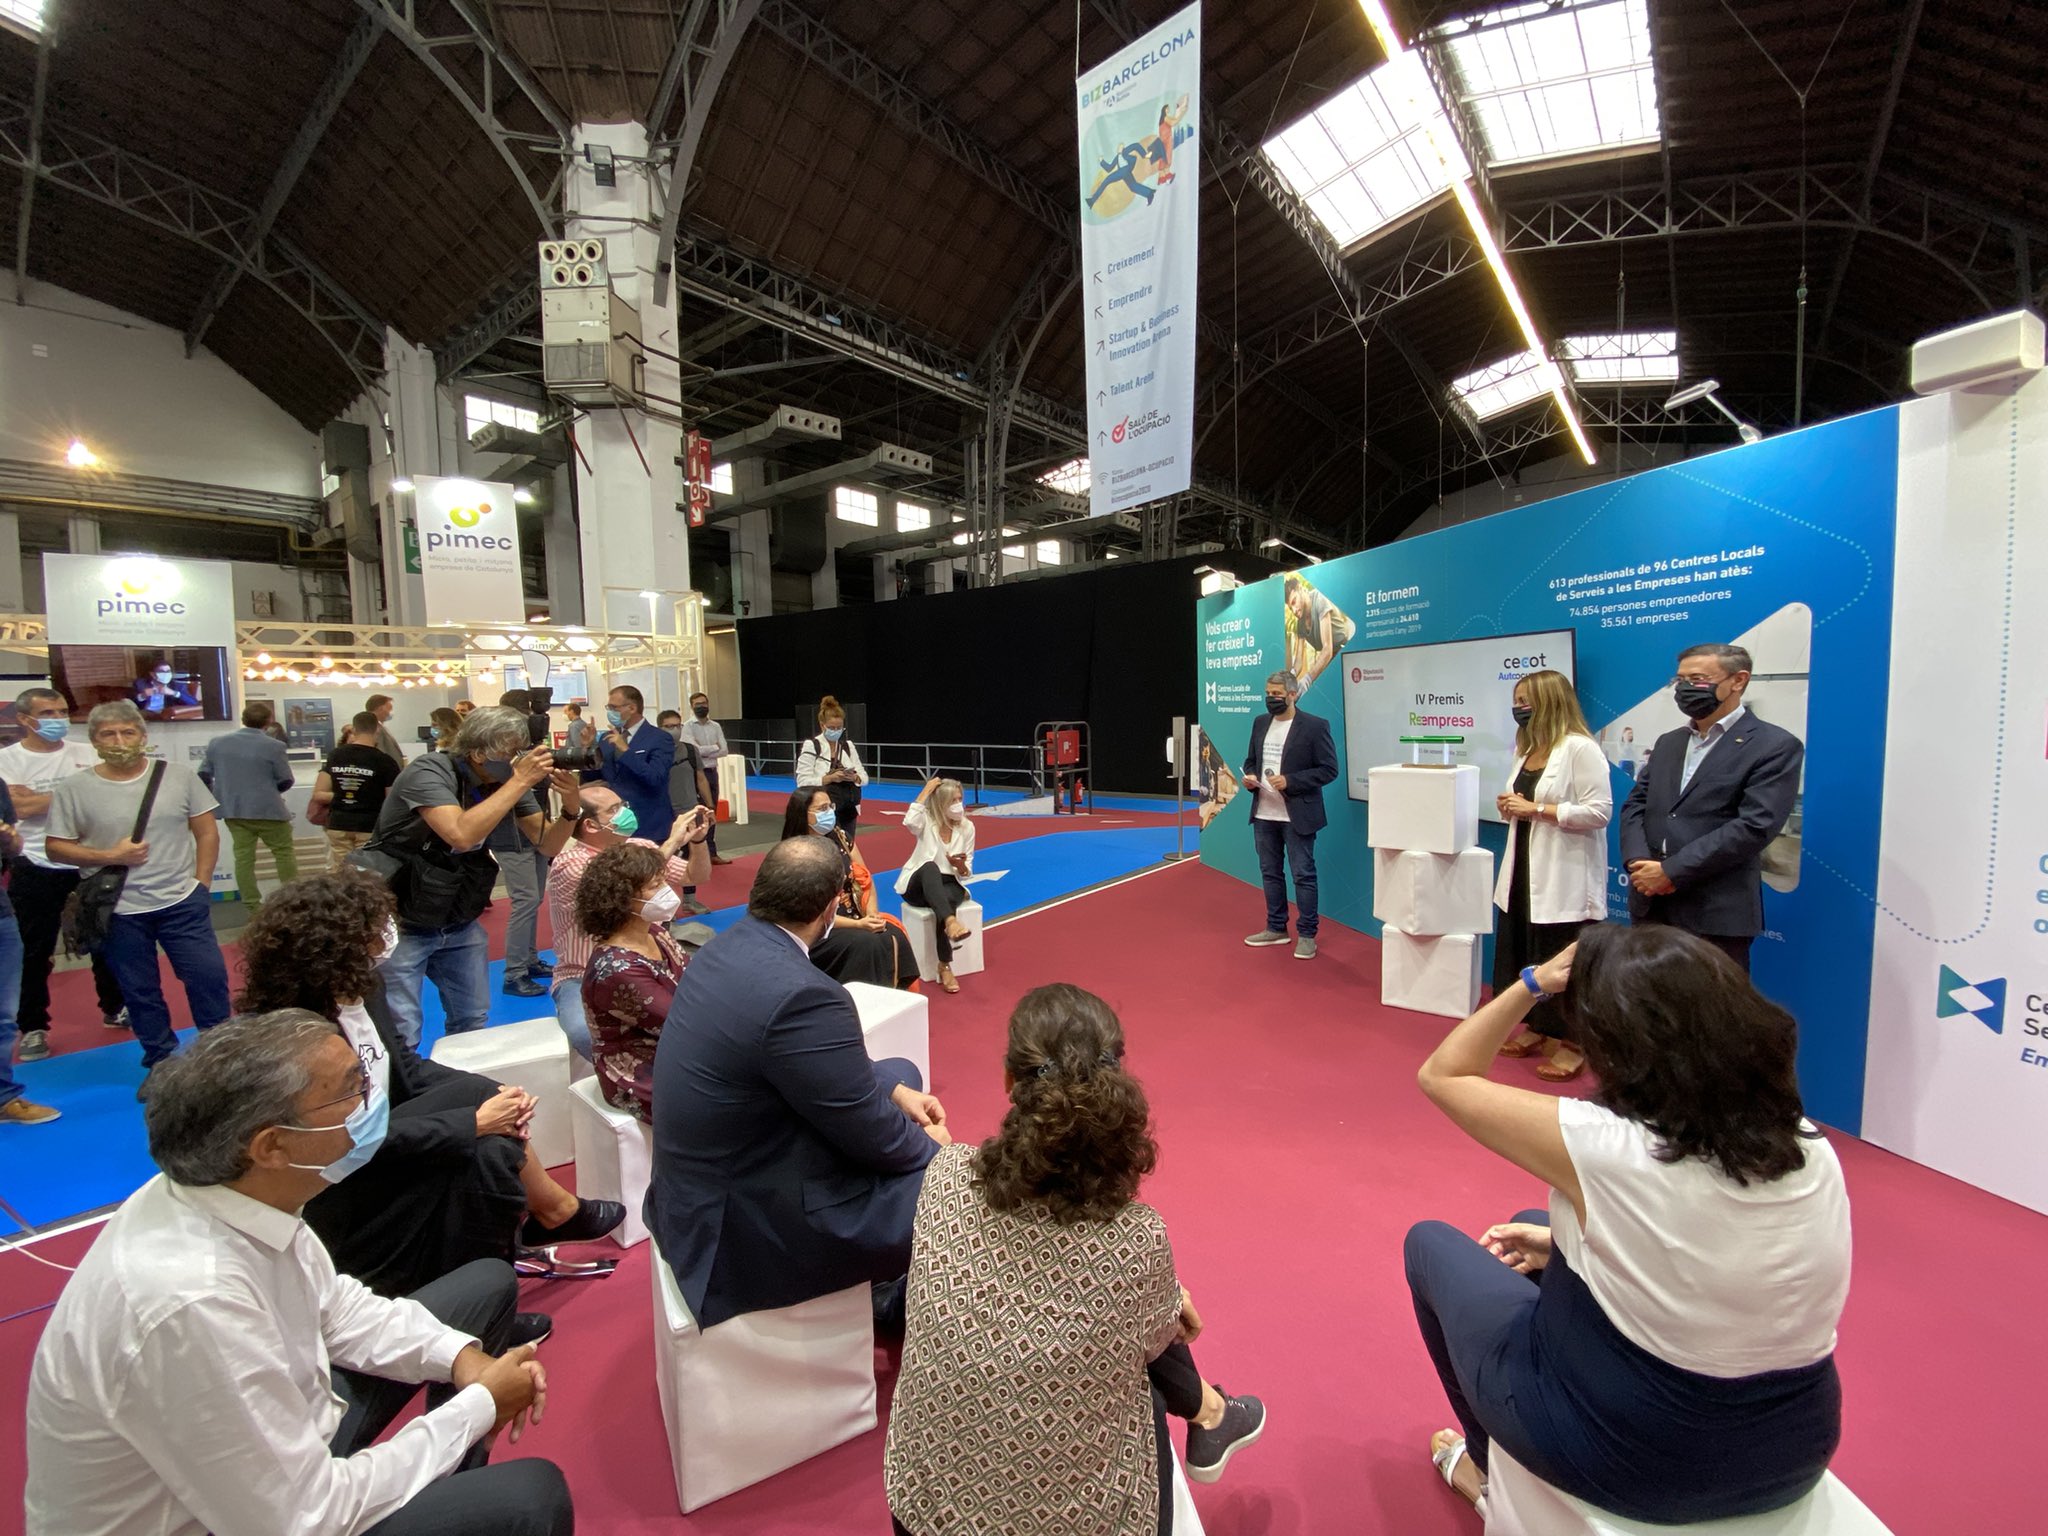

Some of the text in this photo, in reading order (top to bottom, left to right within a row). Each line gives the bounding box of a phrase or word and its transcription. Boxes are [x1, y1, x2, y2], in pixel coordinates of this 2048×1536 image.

[1081, 28, 1195, 109] BIZBARCELONA
[1107, 246, 1155, 275] Creixement
[1108, 285, 1152, 311] Emprendre
[1109, 304, 1179, 345] Startup & Business
[1109, 326, 1171, 361] Innovation Arena
[1110, 380, 1134, 396] Talent
[1128, 409, 1159, 430] SALÓ DE
[426, 524, 513, 551] pimec
[1549, 545, 1765, 589] 613 professionals de 96 Centres Locals
[1556, 564, 1753, 602] de Serveis a les Empreses han atès:
[97, 592, 186, 617] pimec
[1366, 585, 1420, 606] Et formem
[1569, 589, 1732, 618] 74.854 persones emprenedores
[1205, 617, 1251, 636] Vols crear o
[1600, 610, 1689, 628] 35.561 empreses
[1205, 632, 1255, 653] fer créixer la
[1205, 648, 1263, 671] teva empresa?
[1503, 653, 1547, 669] cecot
[1415, 692, 1465, 706] IV Premis
[1409, 711, 1475, 729] Reempresa
[331, 766, 374, 777] TRAFFICKER
